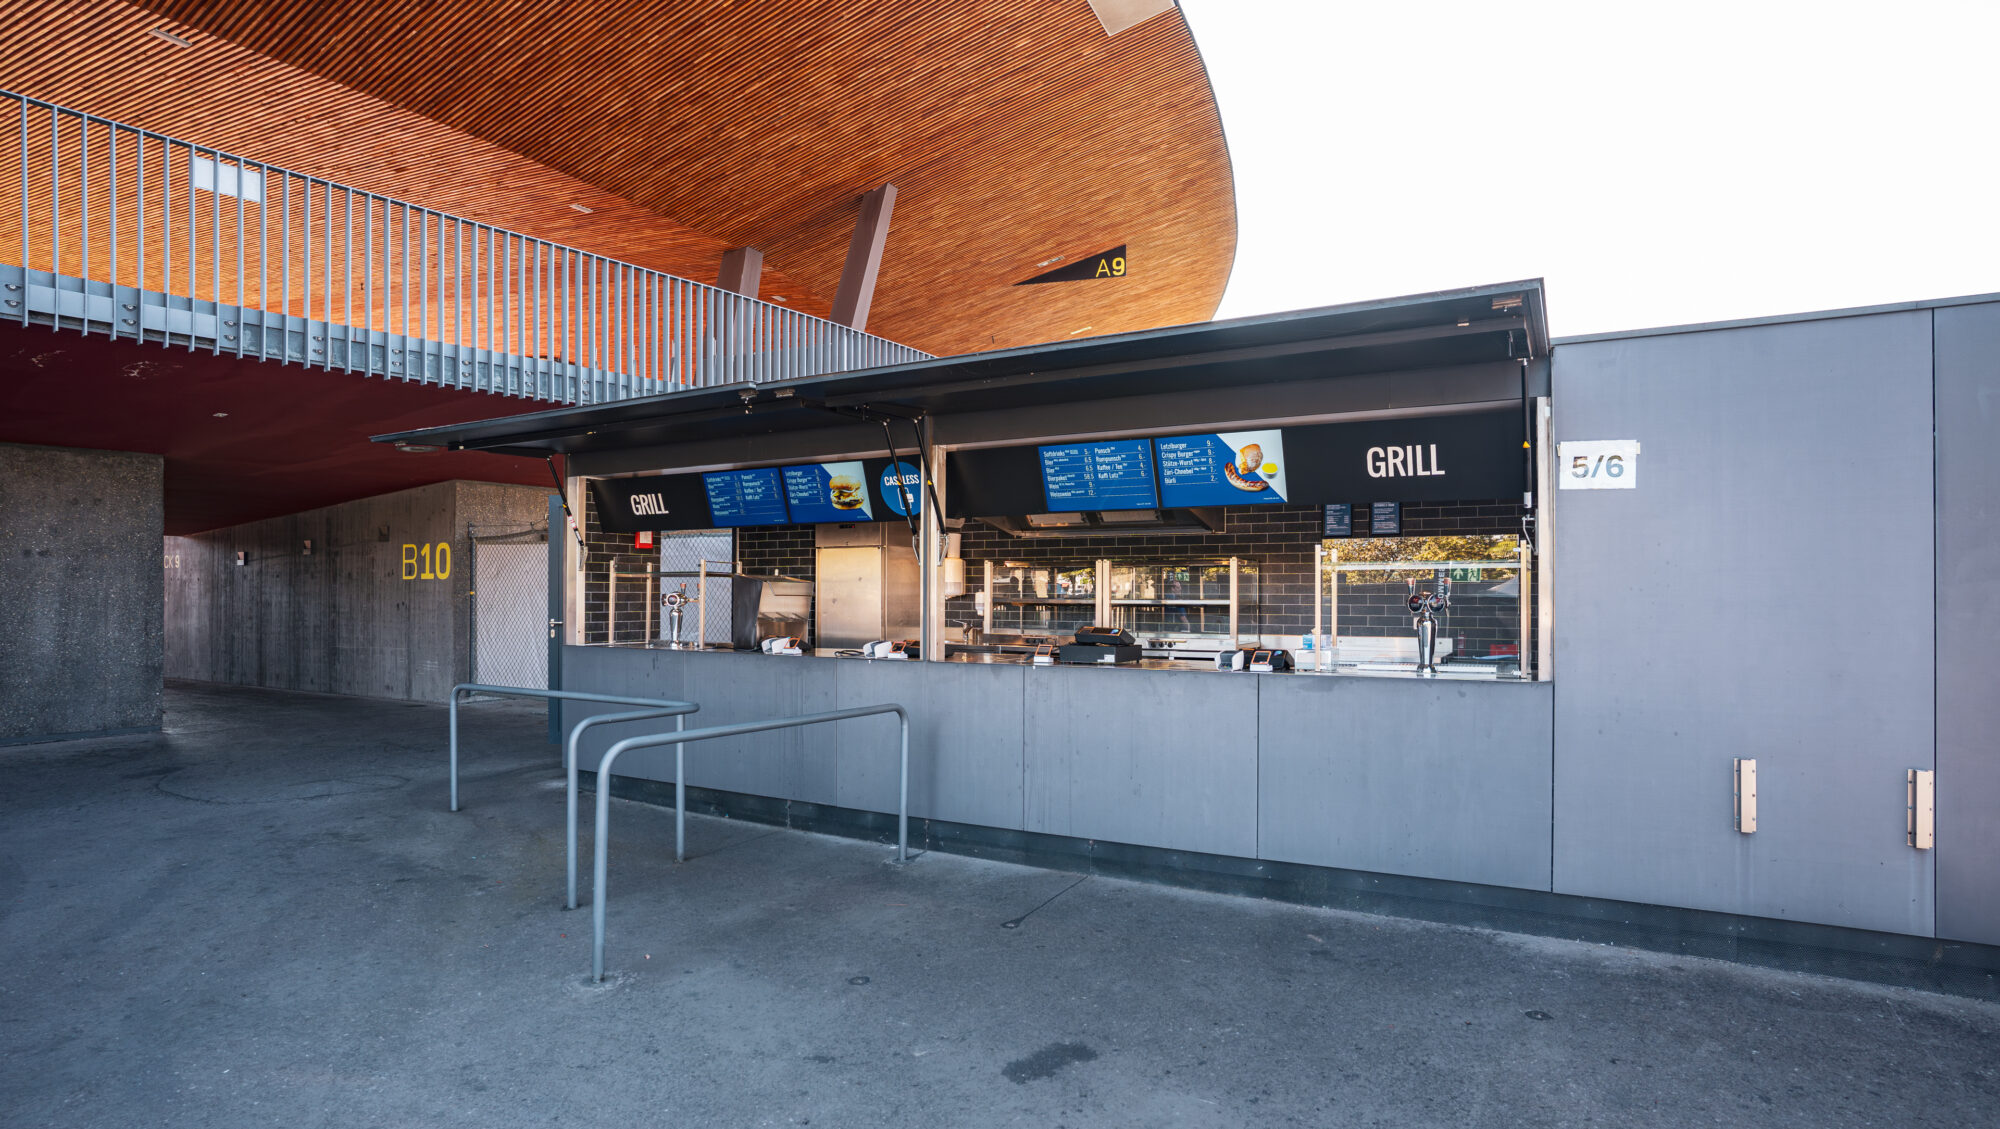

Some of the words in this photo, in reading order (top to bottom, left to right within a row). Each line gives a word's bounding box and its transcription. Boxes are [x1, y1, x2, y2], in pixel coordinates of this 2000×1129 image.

[1095, 257, 1126, 278] A9
[1366, 443, 1446, 479] GRILL
[1571, 454, 1625, 479] 5/6
[884, 474, 920, 486] CASLESS
[630, 492, 669, 516] GRILL
[174, 554, 180, 569] 9
[402, 542, 451, 581] B10
